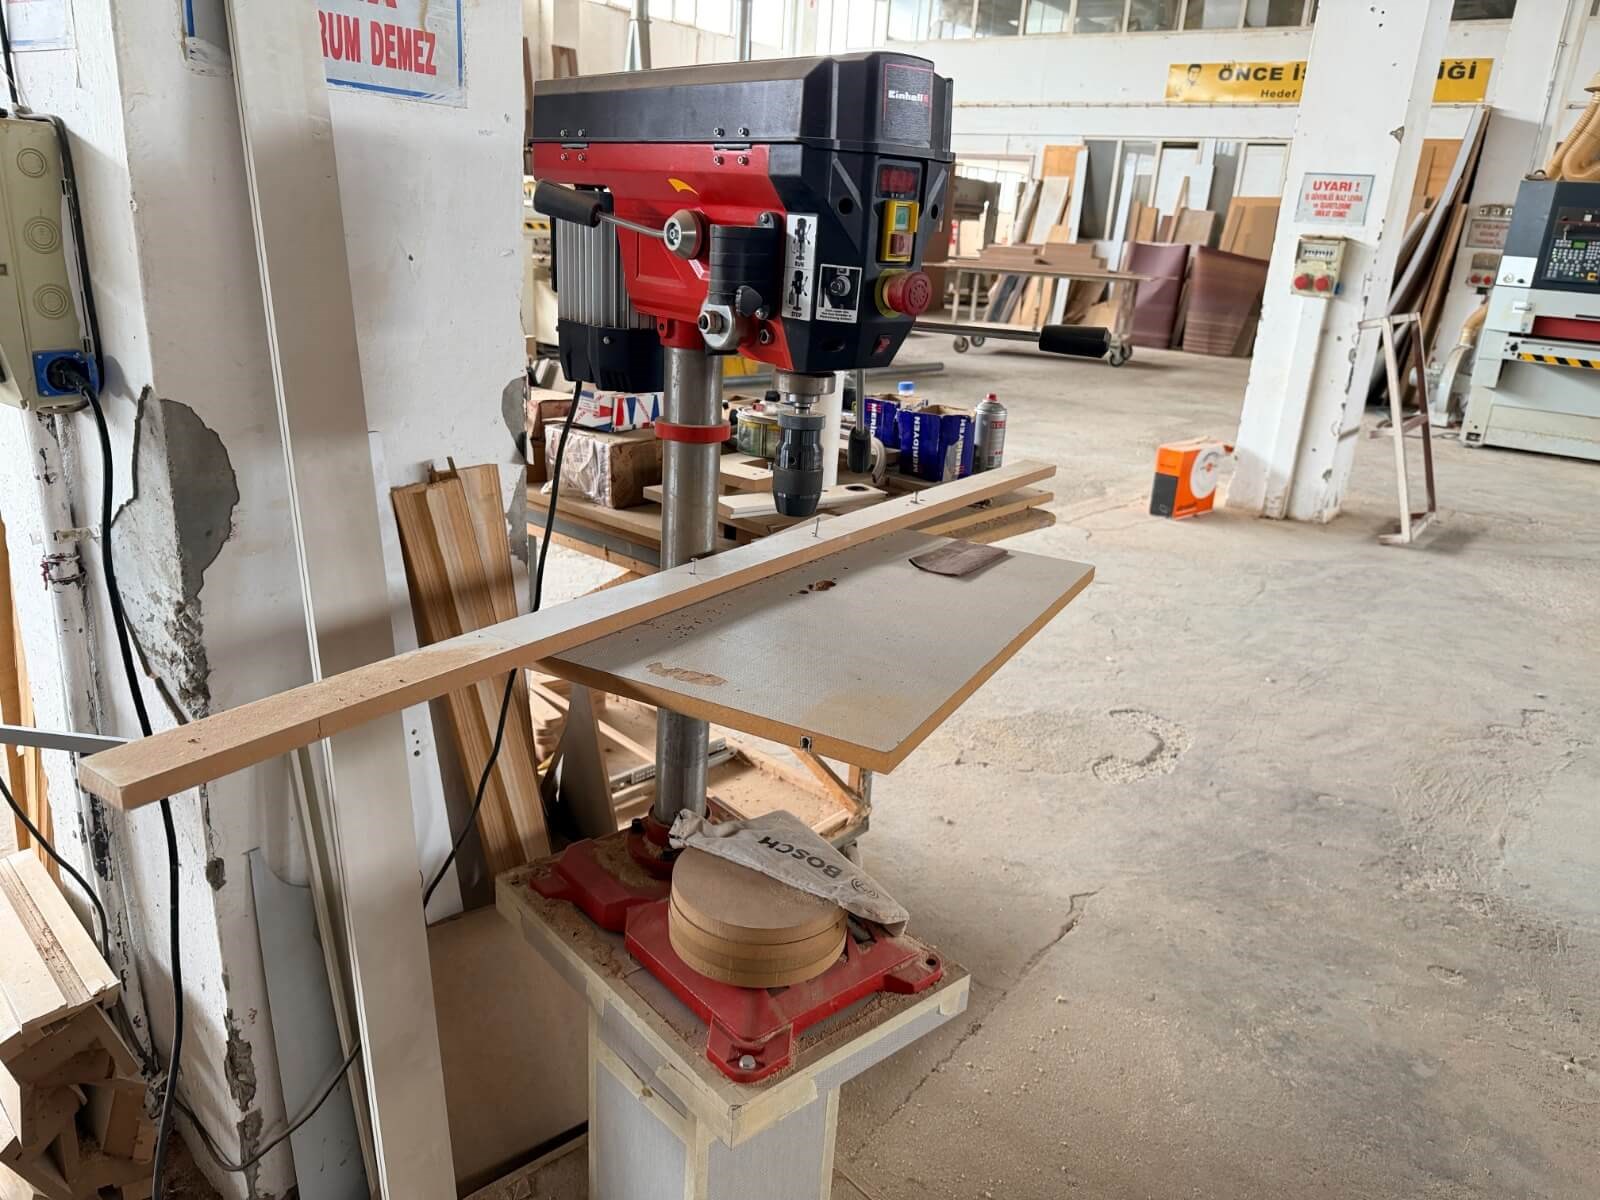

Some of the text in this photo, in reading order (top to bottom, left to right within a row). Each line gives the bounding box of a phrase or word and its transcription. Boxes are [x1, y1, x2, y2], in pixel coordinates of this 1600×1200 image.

[370, 21, 437, 76] DEMEZ
[1218, 64, 1284, 81] ÖNCE
[1260, 89, 1297, 98] Hedef
[1313, 181, 1353, 191] UYARI
[757, 836, 842, 879] BOSCH
